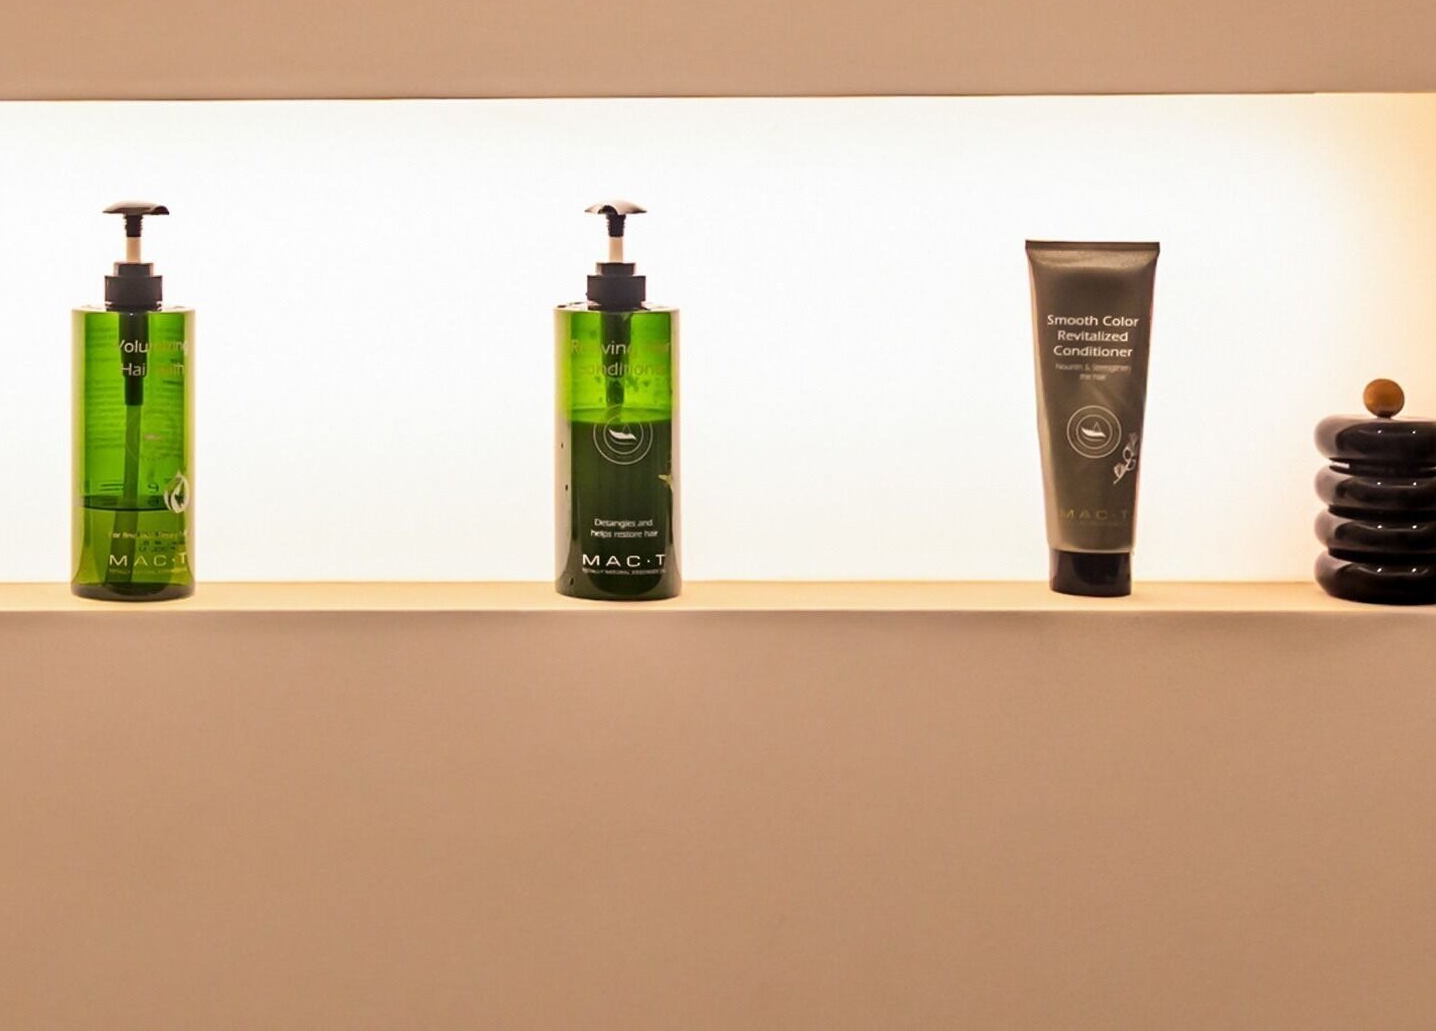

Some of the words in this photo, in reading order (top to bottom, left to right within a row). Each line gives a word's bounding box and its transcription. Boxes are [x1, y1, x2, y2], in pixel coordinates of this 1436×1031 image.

[1047, 314, 1099, 326] Smooth
[1102, 315, 1139, 327] Color
[1057, 330, 1129, 342] Revitalized
[1053, 345, 1134, 357] Conditioner
